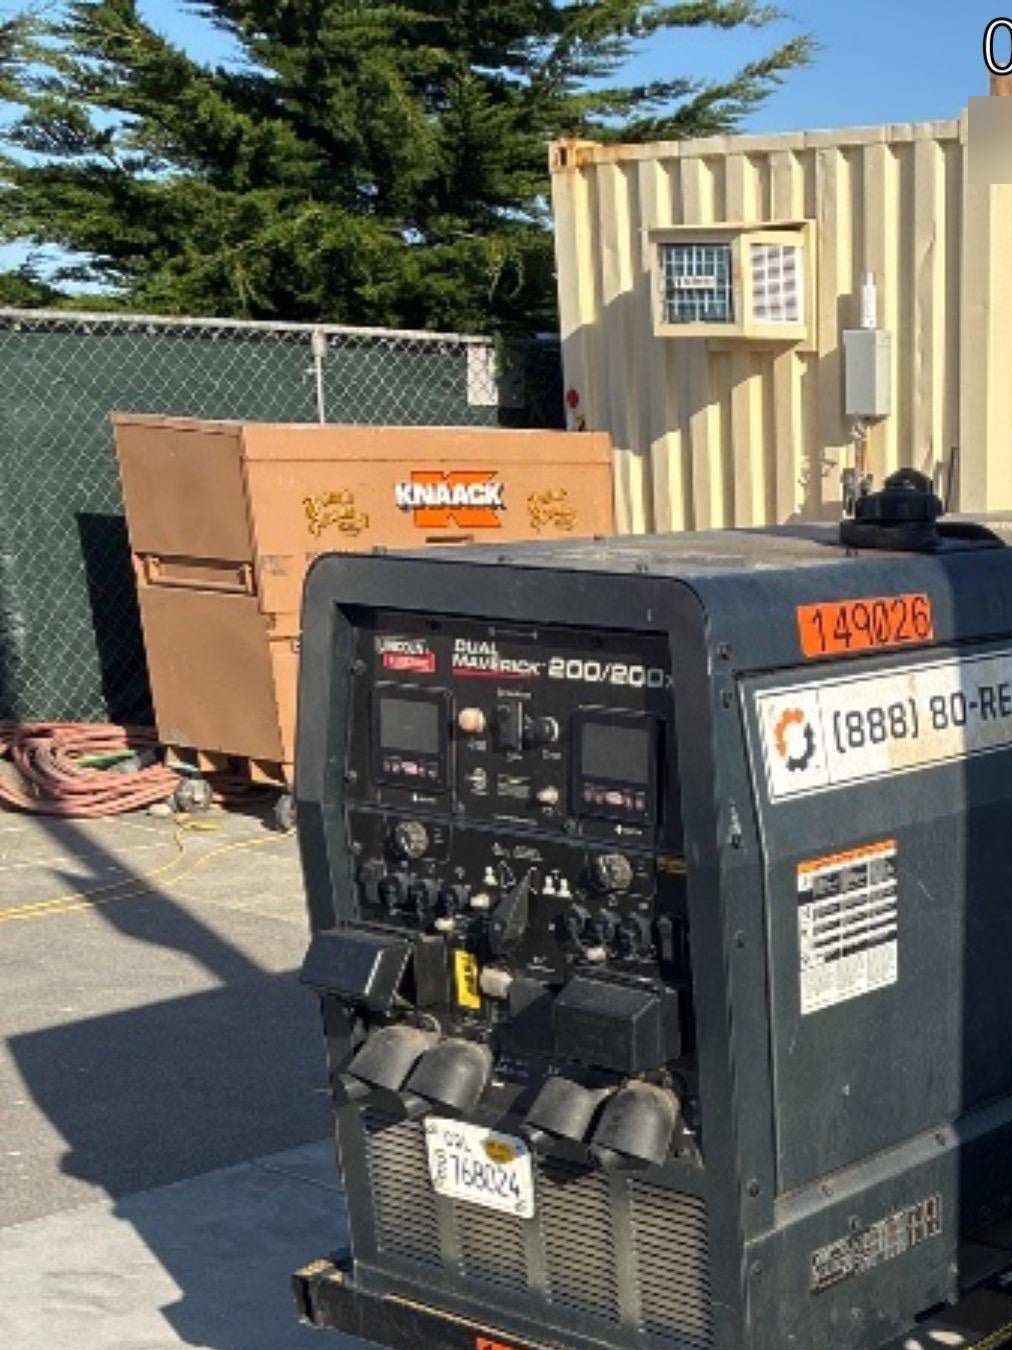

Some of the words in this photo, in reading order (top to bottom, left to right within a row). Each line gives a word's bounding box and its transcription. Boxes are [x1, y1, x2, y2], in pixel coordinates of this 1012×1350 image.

[394, 481, 503, 508] KNAACK
[811, 597, 930, 652] 149026
[454, 637, 496, 655] DUAL
[452, 652, 541, 676] MAVERICK
[833, 697, 919, 753] (888)
